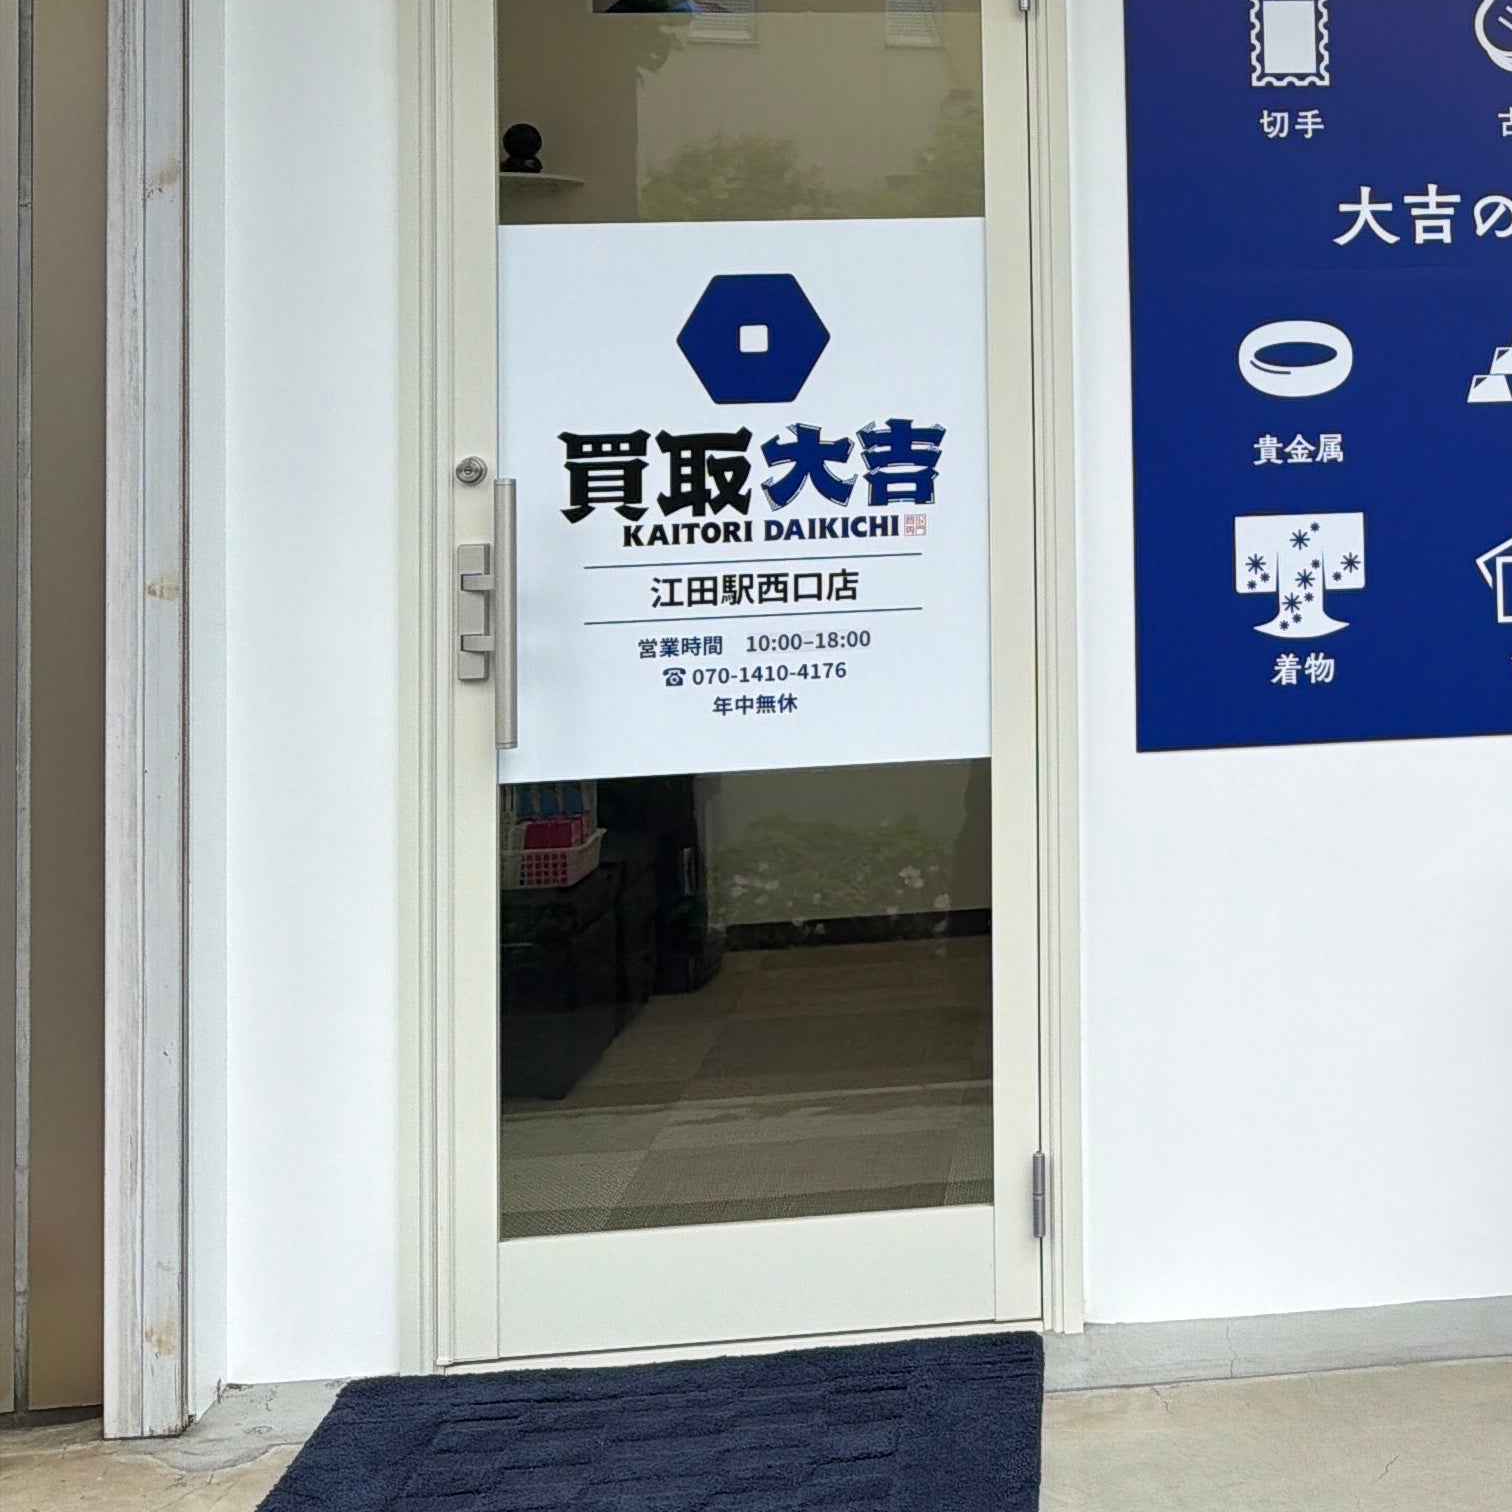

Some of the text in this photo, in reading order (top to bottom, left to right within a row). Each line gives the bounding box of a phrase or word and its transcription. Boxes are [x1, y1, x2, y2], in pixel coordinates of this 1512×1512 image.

[1259, 109, 1325, 139] 切手
[1253, 433, 1344, 466] 貴金属
[557, 418, 947, 523] 買取大吉
[623, 517, 753, 547] KAITORI
[764, 514, 900, 542] DAIKICHI
[649, 568, 860, 608] 江田駅西口店
[638, 635, 723, 659] 営業時間
[692, 661, 847, 686] 070-1410-4176
[1270, 652, 1335, 686] 着物
[712, 692, 798, 717] 年中無休
